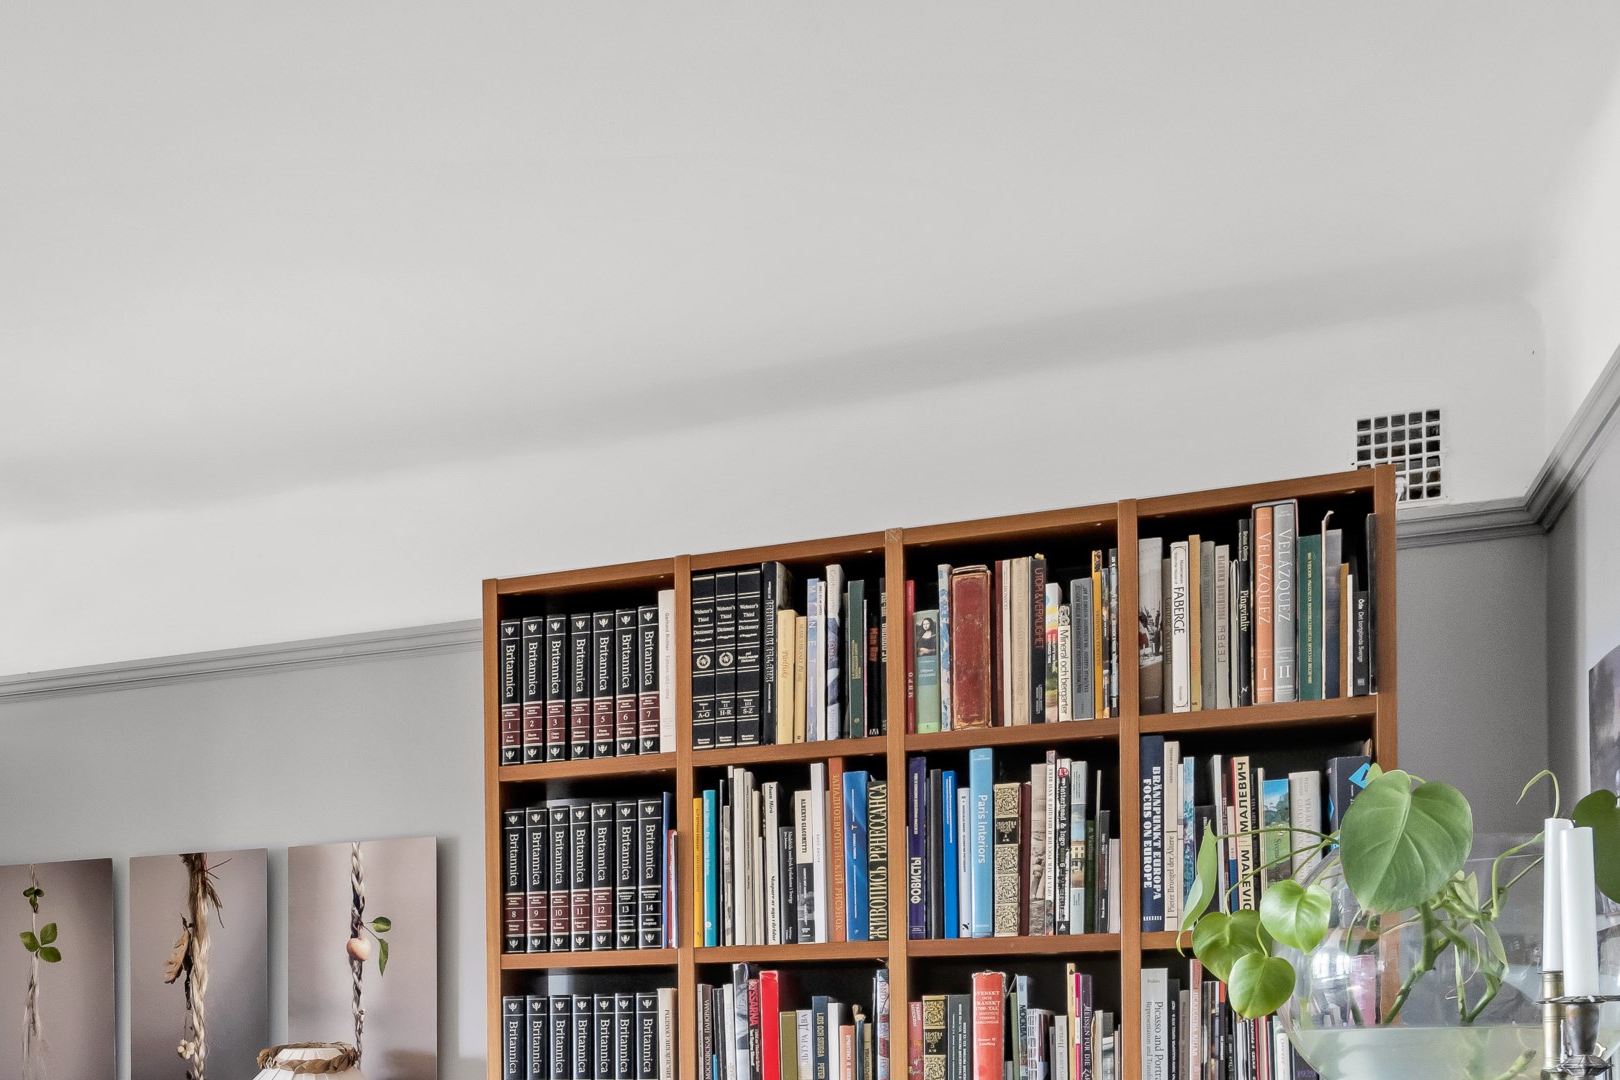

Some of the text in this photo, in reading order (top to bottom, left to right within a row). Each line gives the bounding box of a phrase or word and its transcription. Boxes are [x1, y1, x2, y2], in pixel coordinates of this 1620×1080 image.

[1035, 568, 1044, 592] UTOPI
[1258, 531, 1272, 624] VELÁZQUEZ
[1276, 529, 1292, 622] VELÁZQUEZ
[1035, 599, 1044, 649] VERKLIGHET
[1240, 590, 1250, 632] Pingvinliv
[529, 642, 537, 695] Britannica
[552, 640, 561, 694] Britannica
[576, 639, 585, 692] Britannica
[600, 637, 609, 690] Britannica
[622, 634, 631, 688] Britannica
[644, 631, 654, 685] Britannica
[1060, 630, 1068, 659] Mineral
[1218, 625, 1226, 663] ГЕРБЫ
[506, 645, 515, 697] Britannica
[1060, 678, 1068, 714] bergarter
[1238, 762, 1248, 832] МАЛЕВИЧ
[598, 827, 607, 881] Britannica
[622, 827, 631, 880] Britannica
[646, 825, 655, 879] Britannica
[832, 774, 843, 931] ЗАПАДНОЕВРОПЕЙСКИЙ РИСУНОК
[978, 794, 988, 864] Paris Interiors
[1143, 778, 1152, 888] FOCUS ON EUROPE
[1152, 766, 1162, 900] BRÄNNPUNKT EUROPA
[1166, 836, 1174, 855] Ältere
[510, 833, 519, 886] Britannica
[532, 832, 541, 885] Britannica
[555, 831, 564, 884] Britannica
[577, 829, 585, 883] Britannica
[869, 784, 887, 939] ЖИВОПИСЬ РЕНЕССАНСА
[910, 857, 921, 904] ФОВИСТЫ
[1167, 868, 1175, 892] Bruegel
[1241, 850, 1252, 911] MALEVIC
[1167, 894, 1175, 913] Pieter
[1083, 1003, 1091, 1036] MEISSEN
[1155, 1001, 1164, 1033] Picasso
[1155, 1035, 1164, 1051] and
[509, 1021, 518, 1074] Britannica
[532, 1020, 542, 1074] Britannica
[556, 1020, 565, 1073] Britannica
[578, 1020, 587, 1073] Britannica
[600, 1019, 610, 1072] Britannica
[620, 1019, 629, 1072] Britannica
[643, 1019, 653, 1073] Britannica
